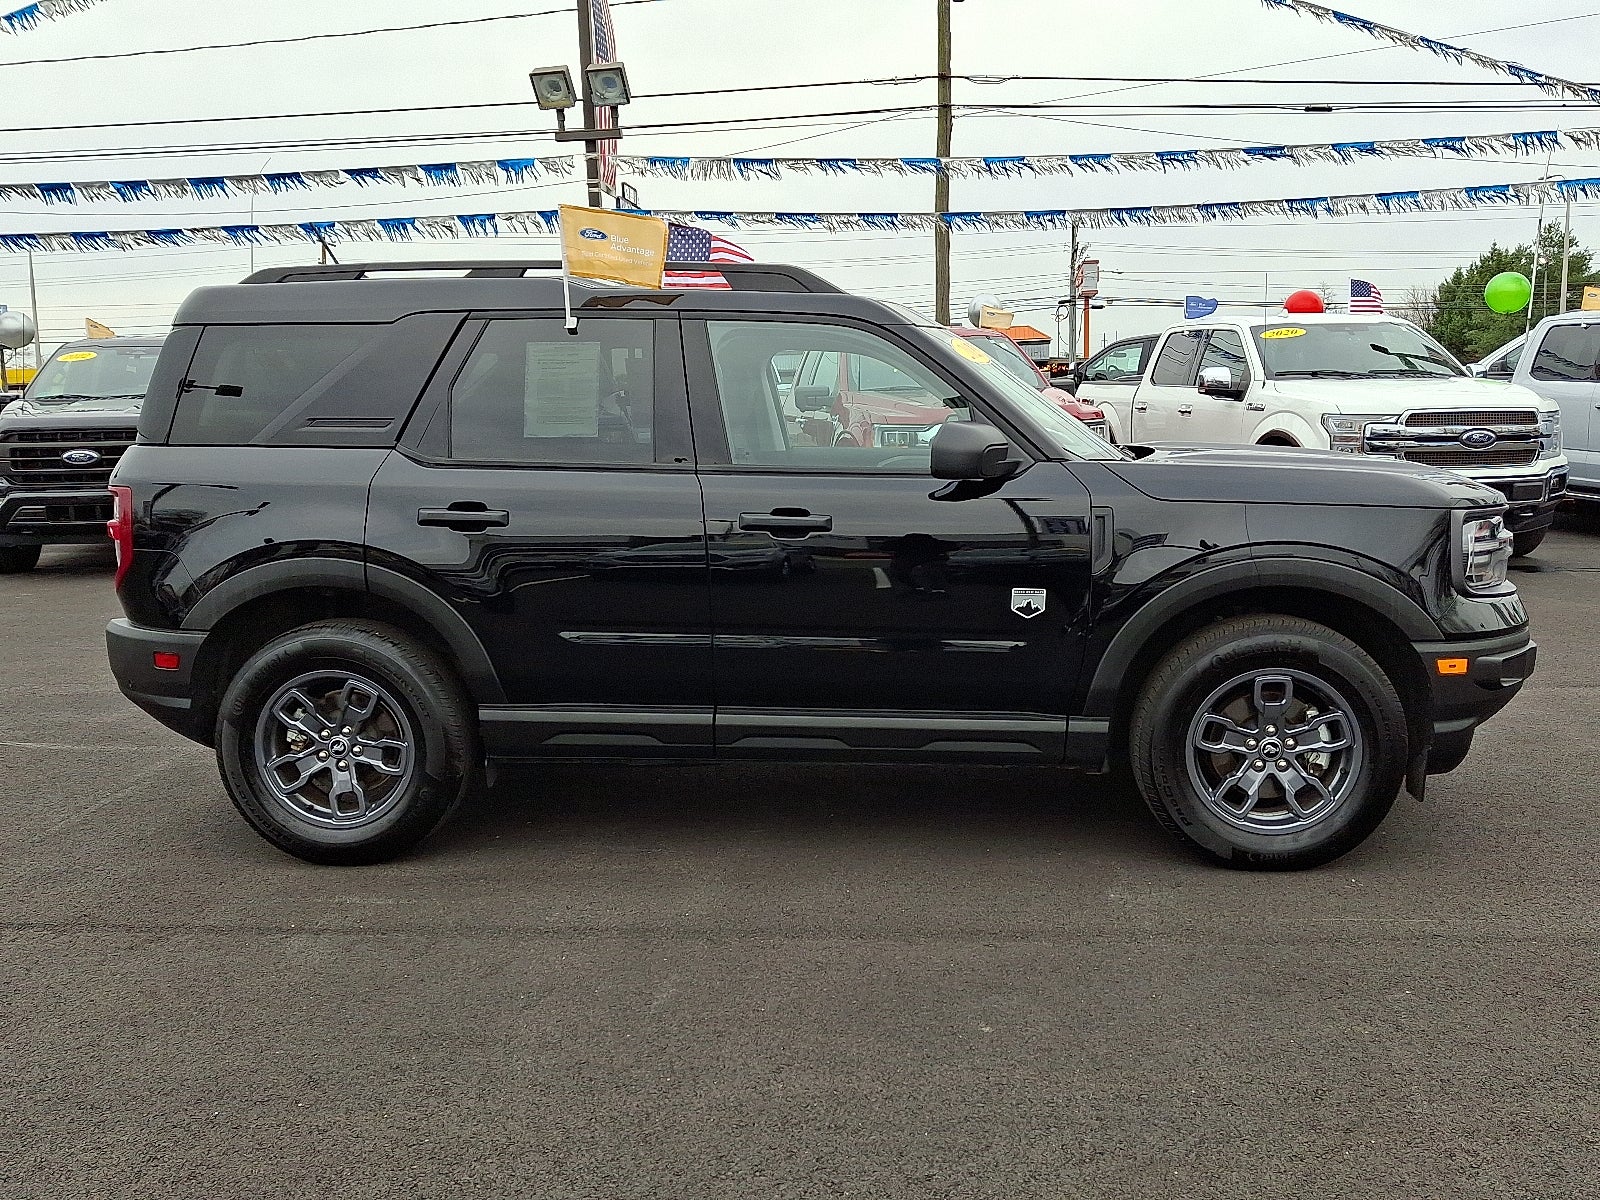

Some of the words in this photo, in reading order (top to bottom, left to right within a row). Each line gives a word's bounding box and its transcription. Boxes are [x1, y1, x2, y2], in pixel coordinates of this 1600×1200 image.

[583, 229, 604, 239] Ford
[610, 234, 629, 243] Blue
[610, 242, 655, 257] Advantage
[1267, 329, 1299, 338] 2020
